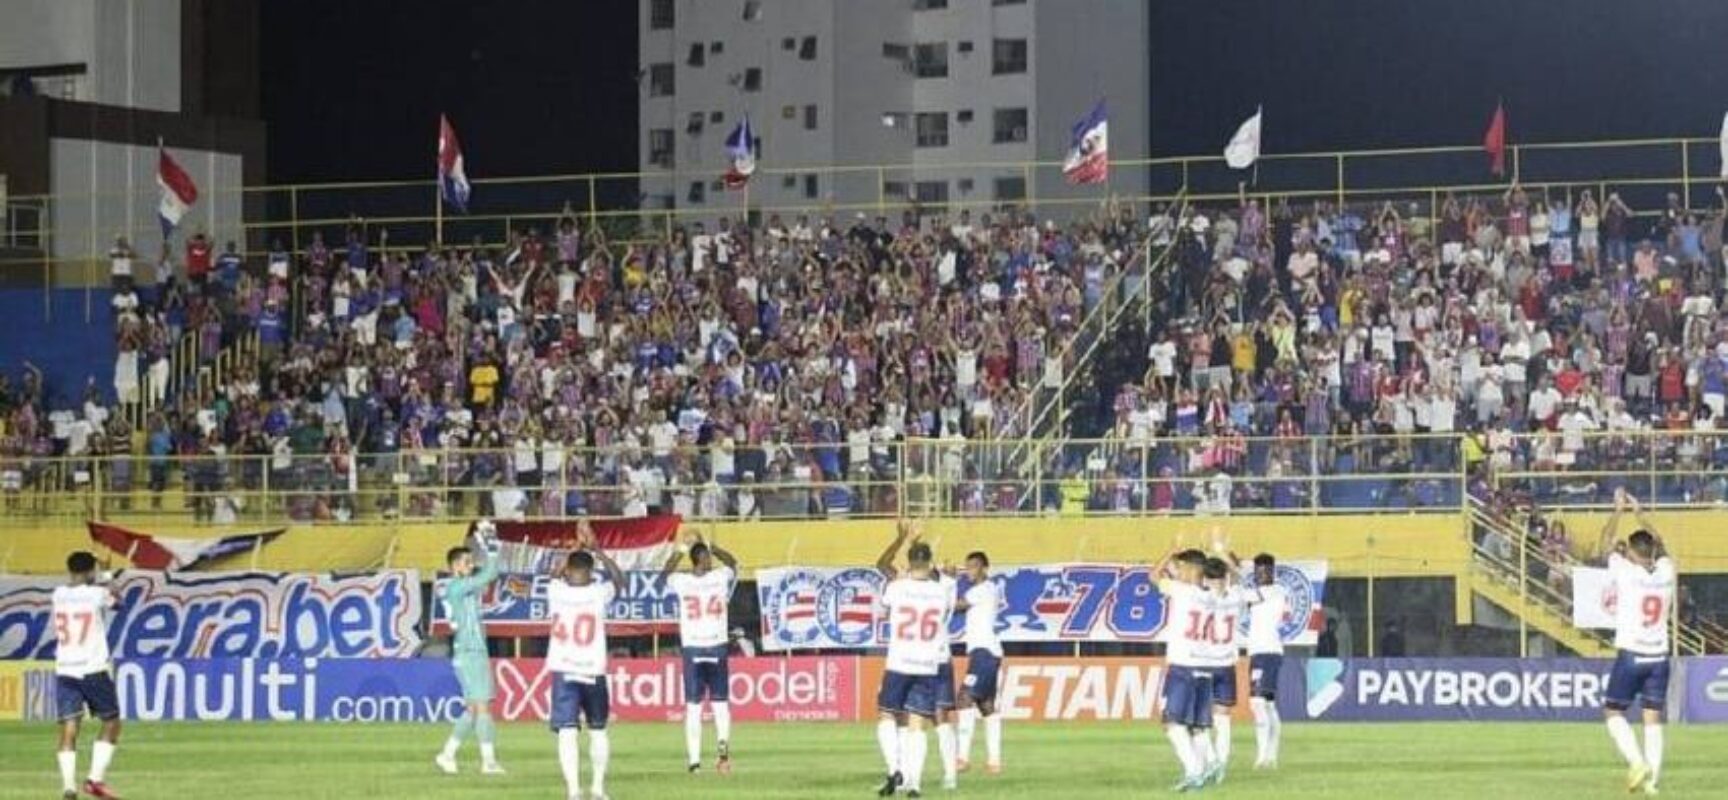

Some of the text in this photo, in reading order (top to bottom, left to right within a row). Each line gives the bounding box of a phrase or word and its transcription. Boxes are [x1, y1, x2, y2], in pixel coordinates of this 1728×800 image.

[683, 594, 722, 620] 34
[897, 606, 940, 641] 26
[1642, 596, 1662, 628] 9
[56, 611, 93, 646] 37
[552, 612, 596, 646] 40
